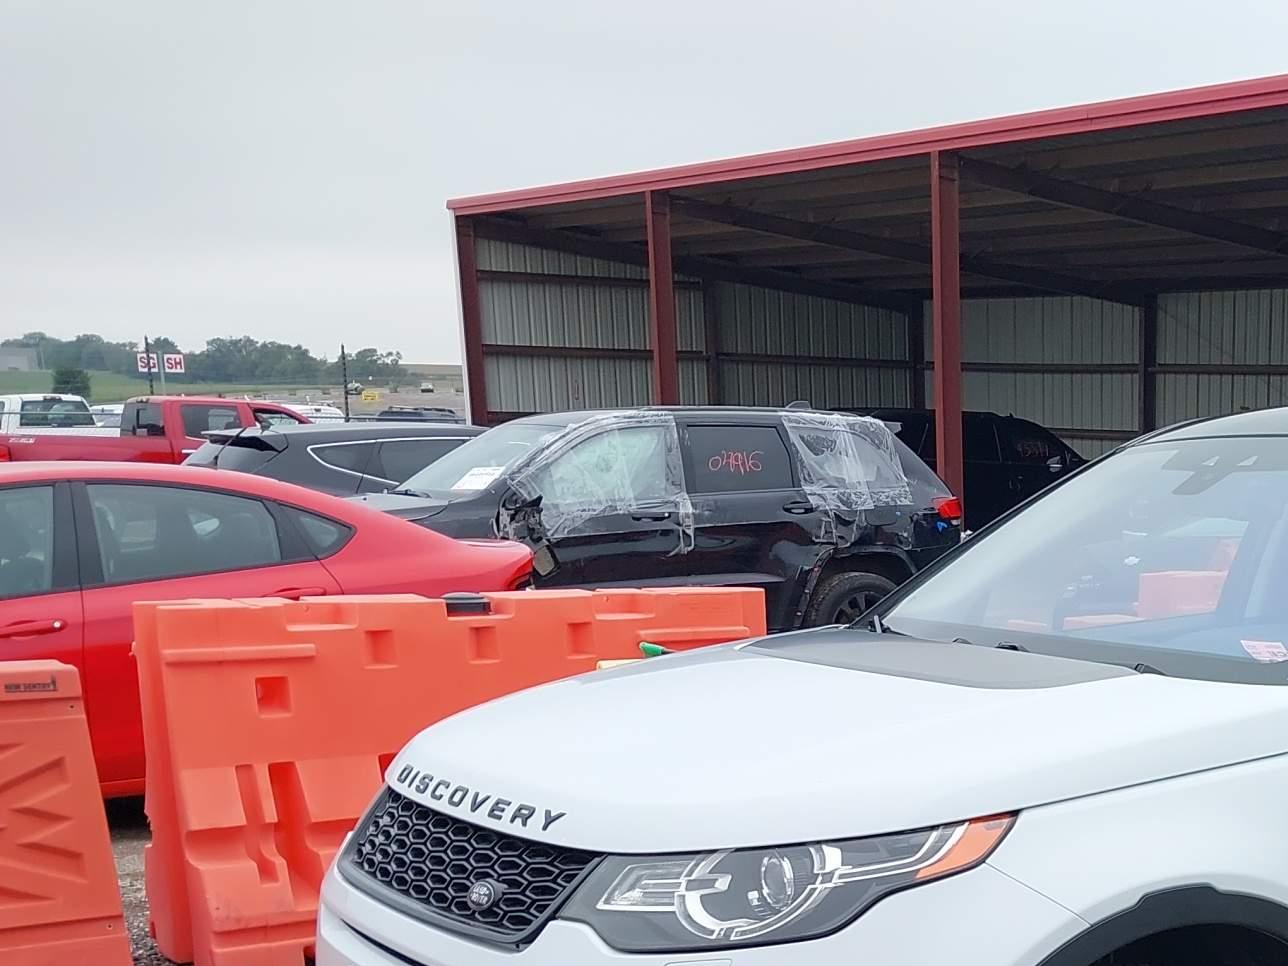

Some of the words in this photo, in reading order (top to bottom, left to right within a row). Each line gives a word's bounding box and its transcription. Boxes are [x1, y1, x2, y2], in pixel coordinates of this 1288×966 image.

[139, 356, 157, 369] SG
[166, 357, 183, 370] SH
[396, 763, 567, 832] DISCOVERY
